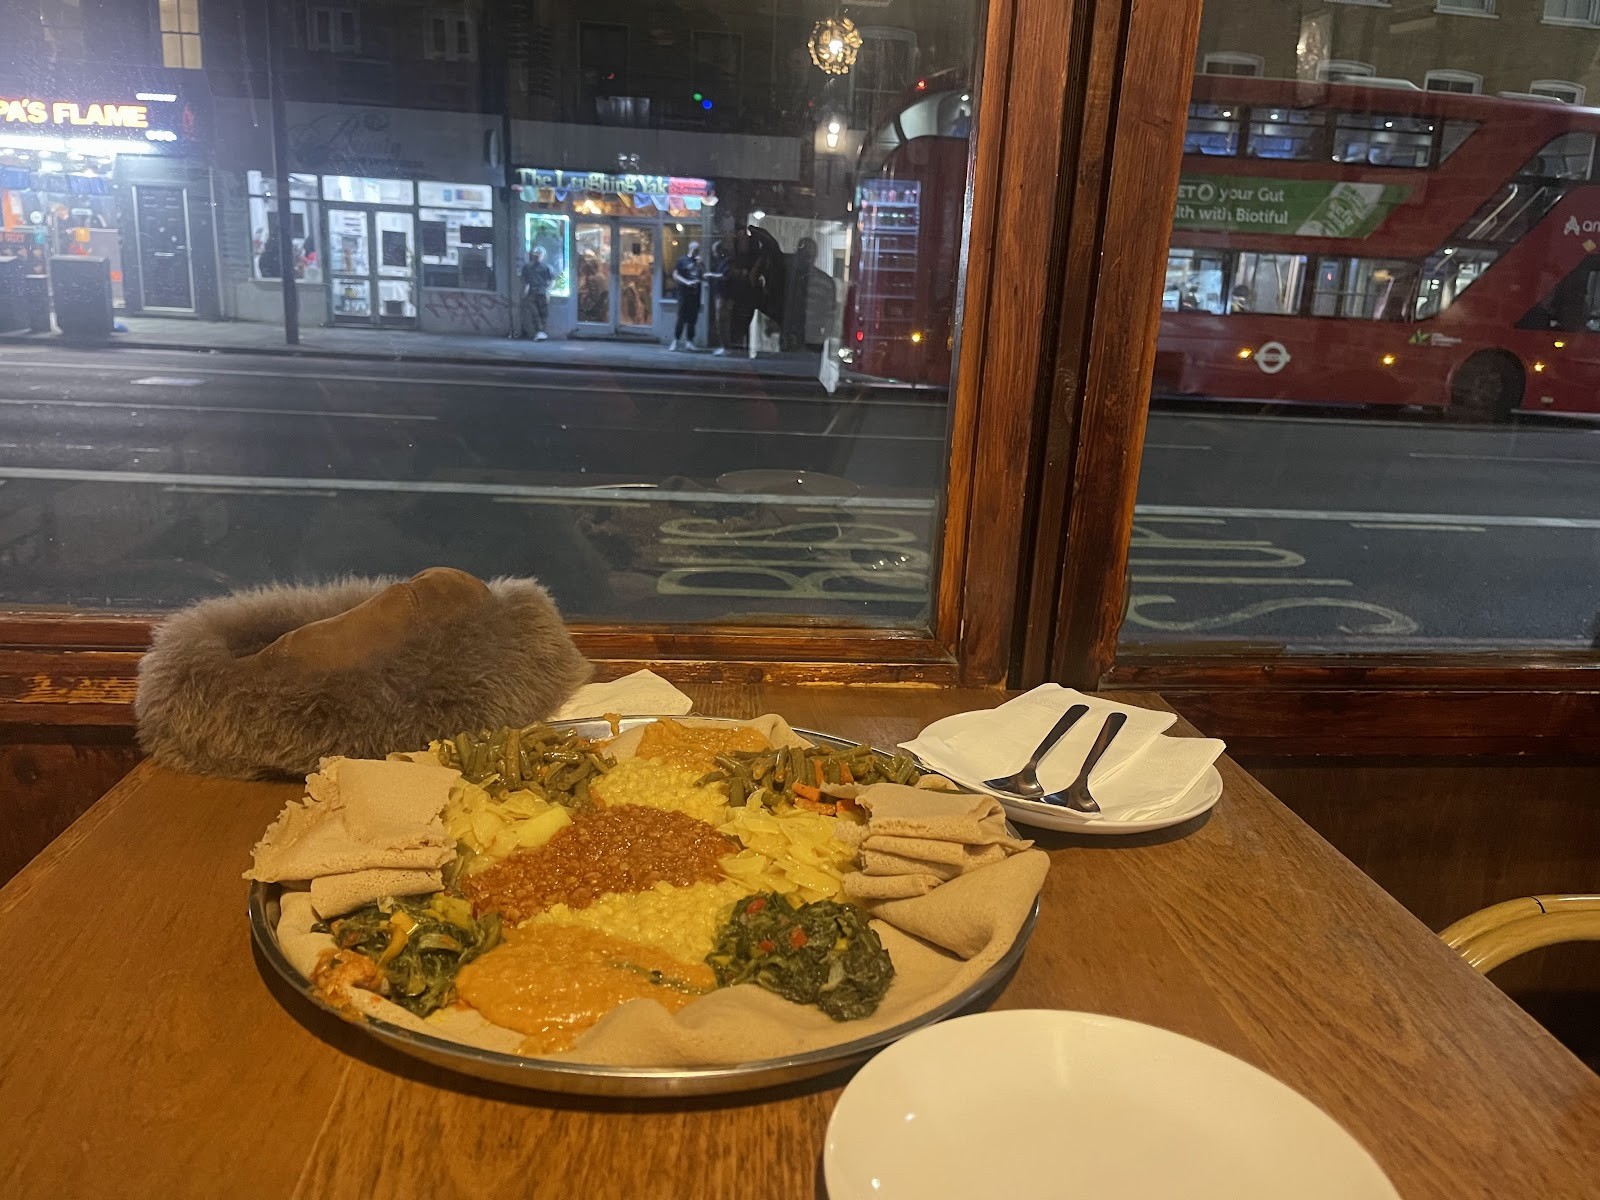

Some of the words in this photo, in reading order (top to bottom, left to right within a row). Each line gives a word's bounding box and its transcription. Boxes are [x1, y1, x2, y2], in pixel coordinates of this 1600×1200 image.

[52, 102, 149, 128] FLAME
[515, 168, 552, 187] The
[637, 174, 669, 195] Yak
[1219, 187, 1254, 203] your
[1257, 187, 1285, 203] Gut
[1199, 206, 1232, 221] with
[1236, 207, 1289, 225] Biotiful
